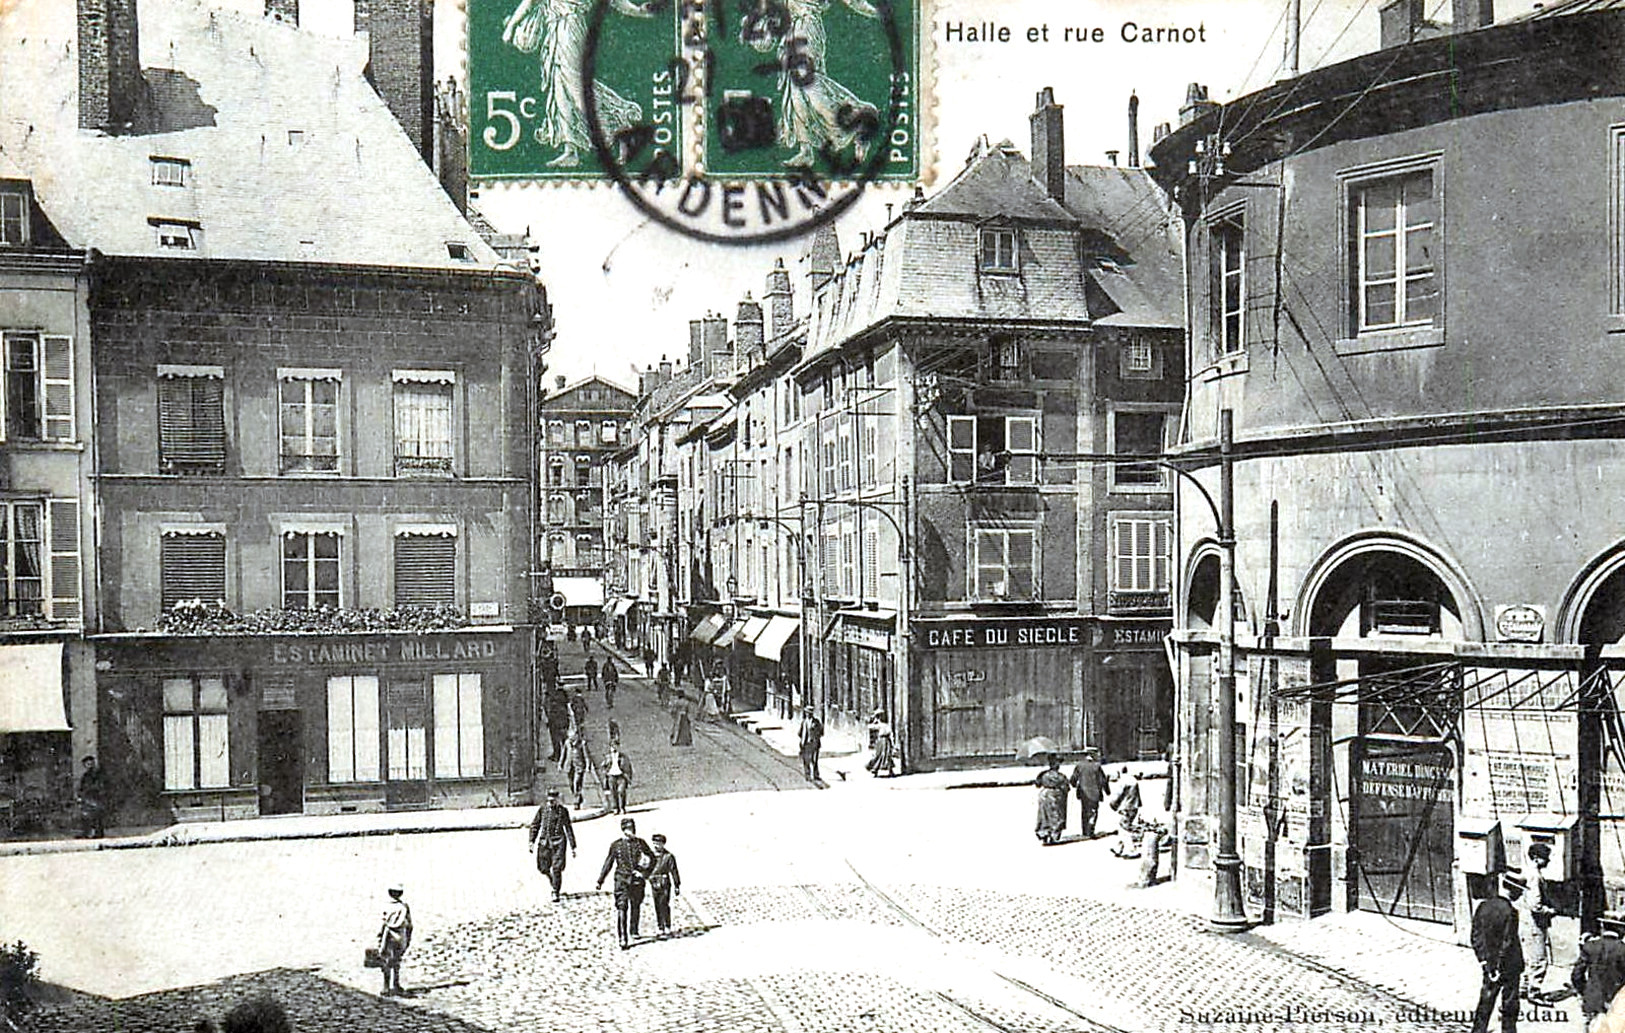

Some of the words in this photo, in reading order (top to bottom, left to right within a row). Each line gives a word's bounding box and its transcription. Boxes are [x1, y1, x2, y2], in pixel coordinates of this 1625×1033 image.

[928, 629, 974, 646] CAFE
[985, 629, 1008, 643] DU
[1018, 628, 1079, 643] SIECLE
[273, 642, 389, 664] ESTAMINET
[401, 640, 495, 660] MILLARD
